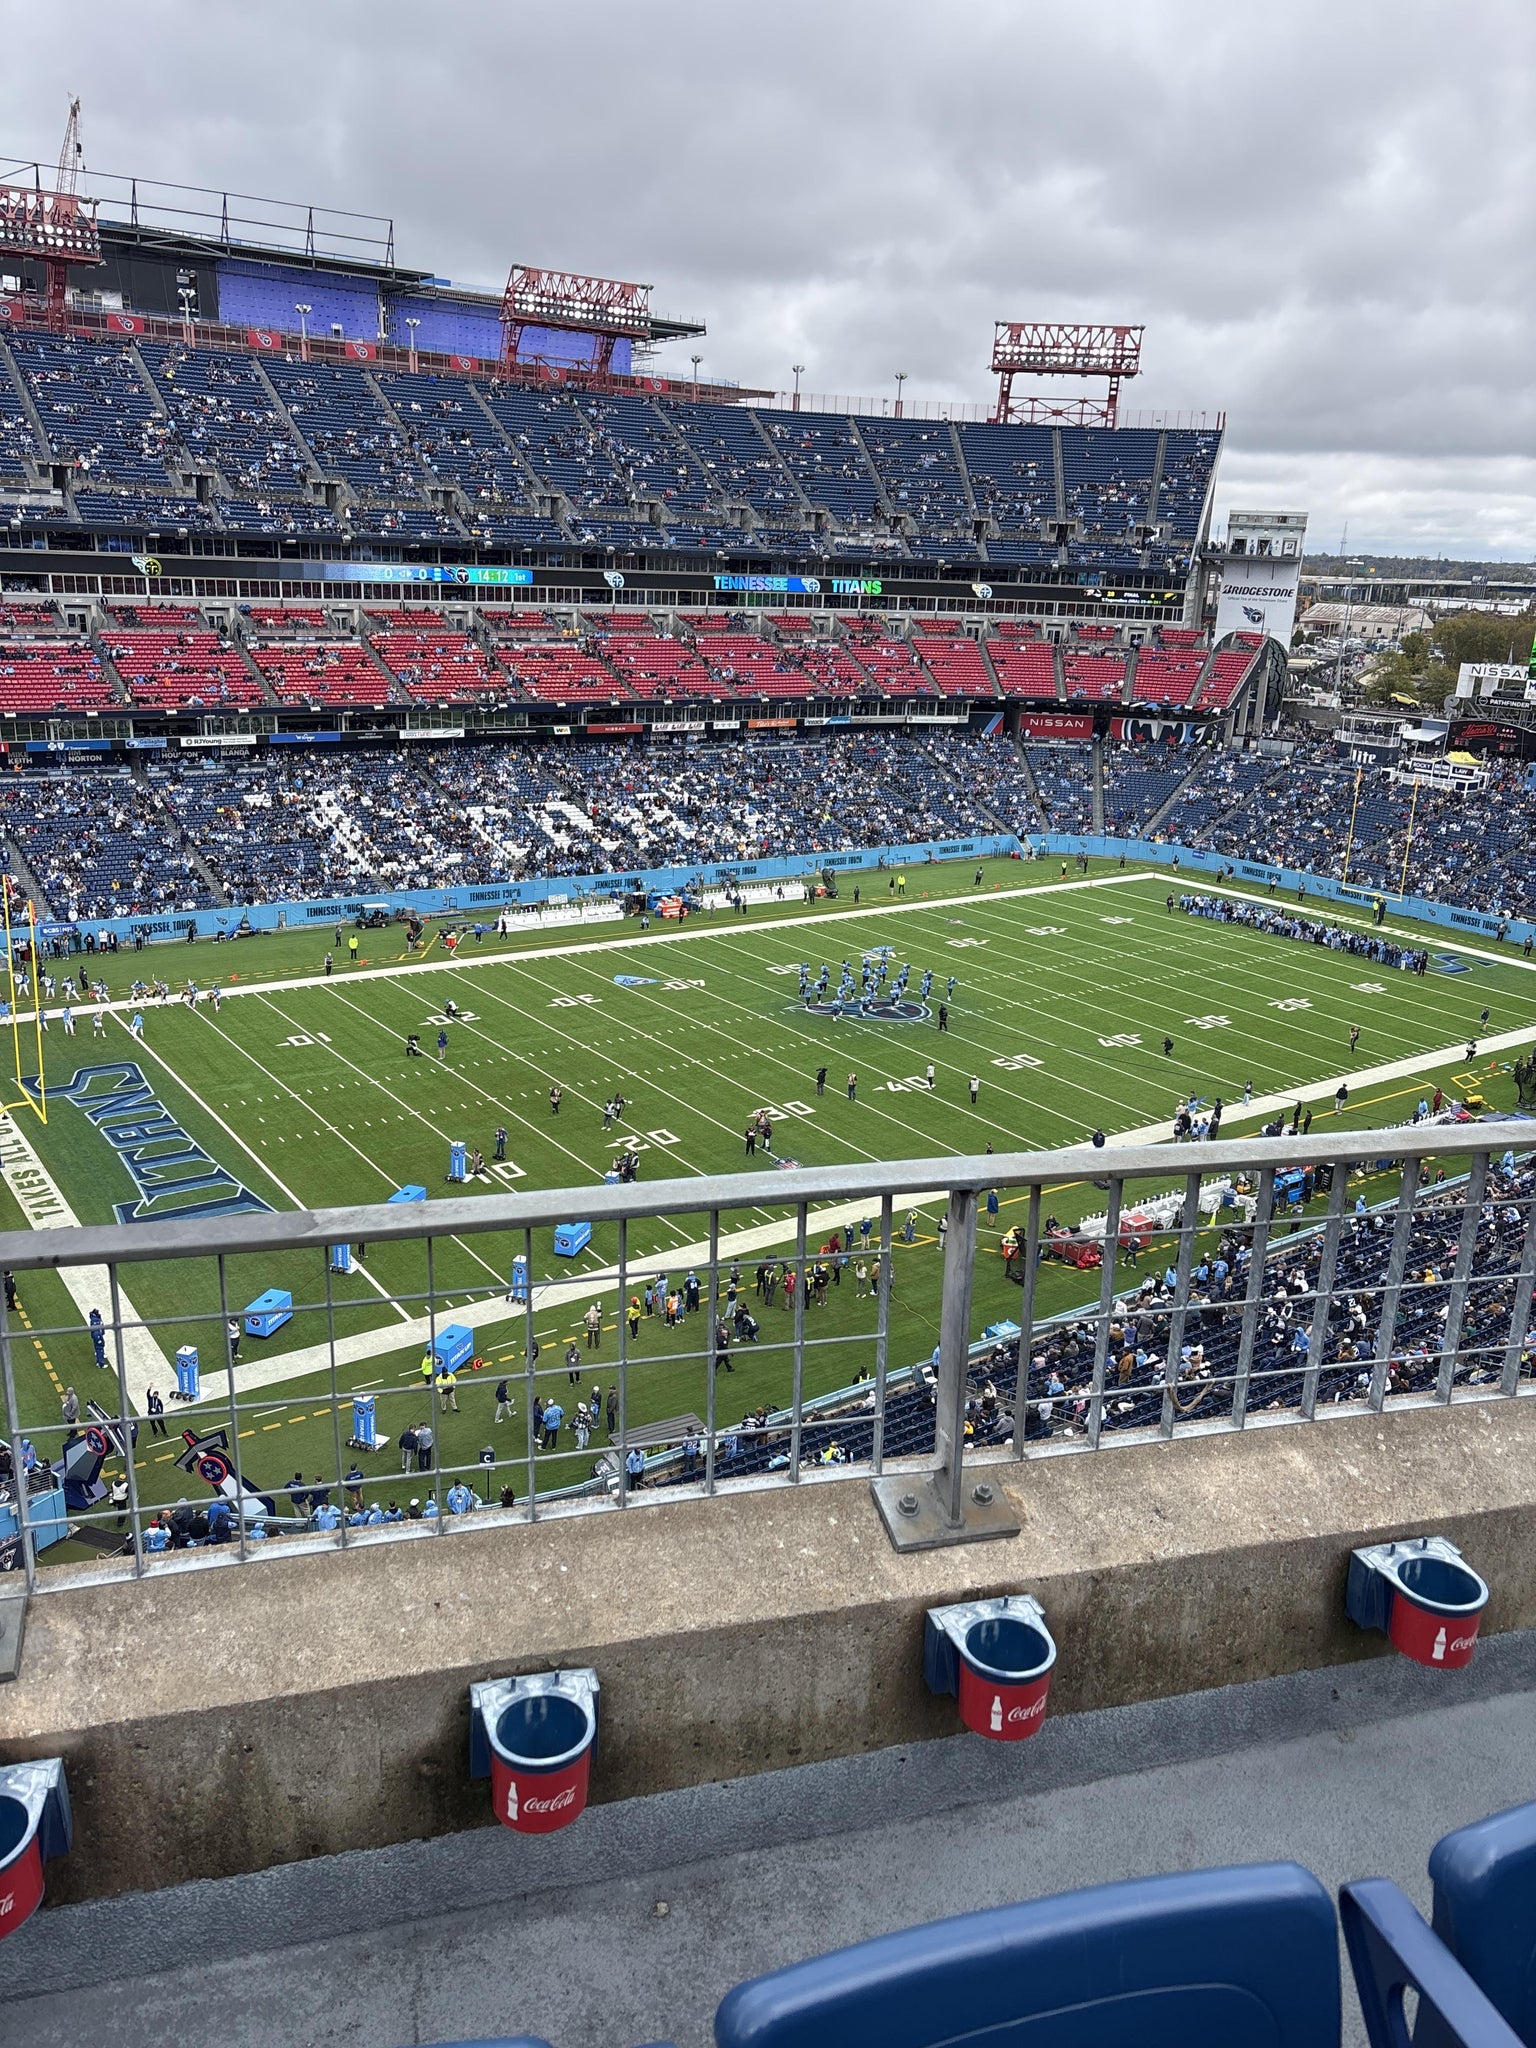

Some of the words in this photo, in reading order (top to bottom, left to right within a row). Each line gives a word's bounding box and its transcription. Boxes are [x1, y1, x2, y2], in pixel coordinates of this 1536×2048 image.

[384, 567, 393, 579] 0
[418, 568, 428, 580] 0
[476, 569, 509, 582] 14:12
[513, 572, 526, 582] 1st
[713, 576, 789, 591] TENNESSEE
[832, 579, 883, 595] TITANS
[1222, 585, 1295, 598] BRIDGESTONE
[1489, 699, 1530, 709] PATHFINDER
[1030, 718, 1084, 728] NISSAN
[68, 755, 102, 763] NORTON
[1352, 749, 1377, 764] lite
[1413, 762, 1431, 770] ROCKY
[595, 879, 623, 889] TENNESSEE
[469, 890, 501, 902] TENNESSEE
[306, 905, 341, 918] TENNESSEE
[1451, 913, 1481, 927] TENNESSEE
[1482, 920, 1500, 932] TOUG
[664, 977, 706, 991] 40
[1350, 982, 1387, 994] 10
[551, 993, 603, 1008] 30
[1267, 998, 1314, 1012] 20
[425, 1010, 482, 1027] 20
[1184, 1014, 1232, 1030] 30
[287, 1031, 333, 1047] 10
[1099, 1033, 1143, 1048] 40
[990, 1053, 1046, 1071] 50
[886, 1076, 937, 1093] 40
[755, 1100, 817, 1121] 30
[10, 1061, 280, 1226] TITANS
[615, 1128, 683, 1151] 20
[11, 1168, 65, 1221] TAKES
[476, 1359, 483, 1369] G
[687, 1441, 698, 1450] 22
[483, 1455, 491, 1463] C
[523, 1785, 578, 1813] Coca-Cola
